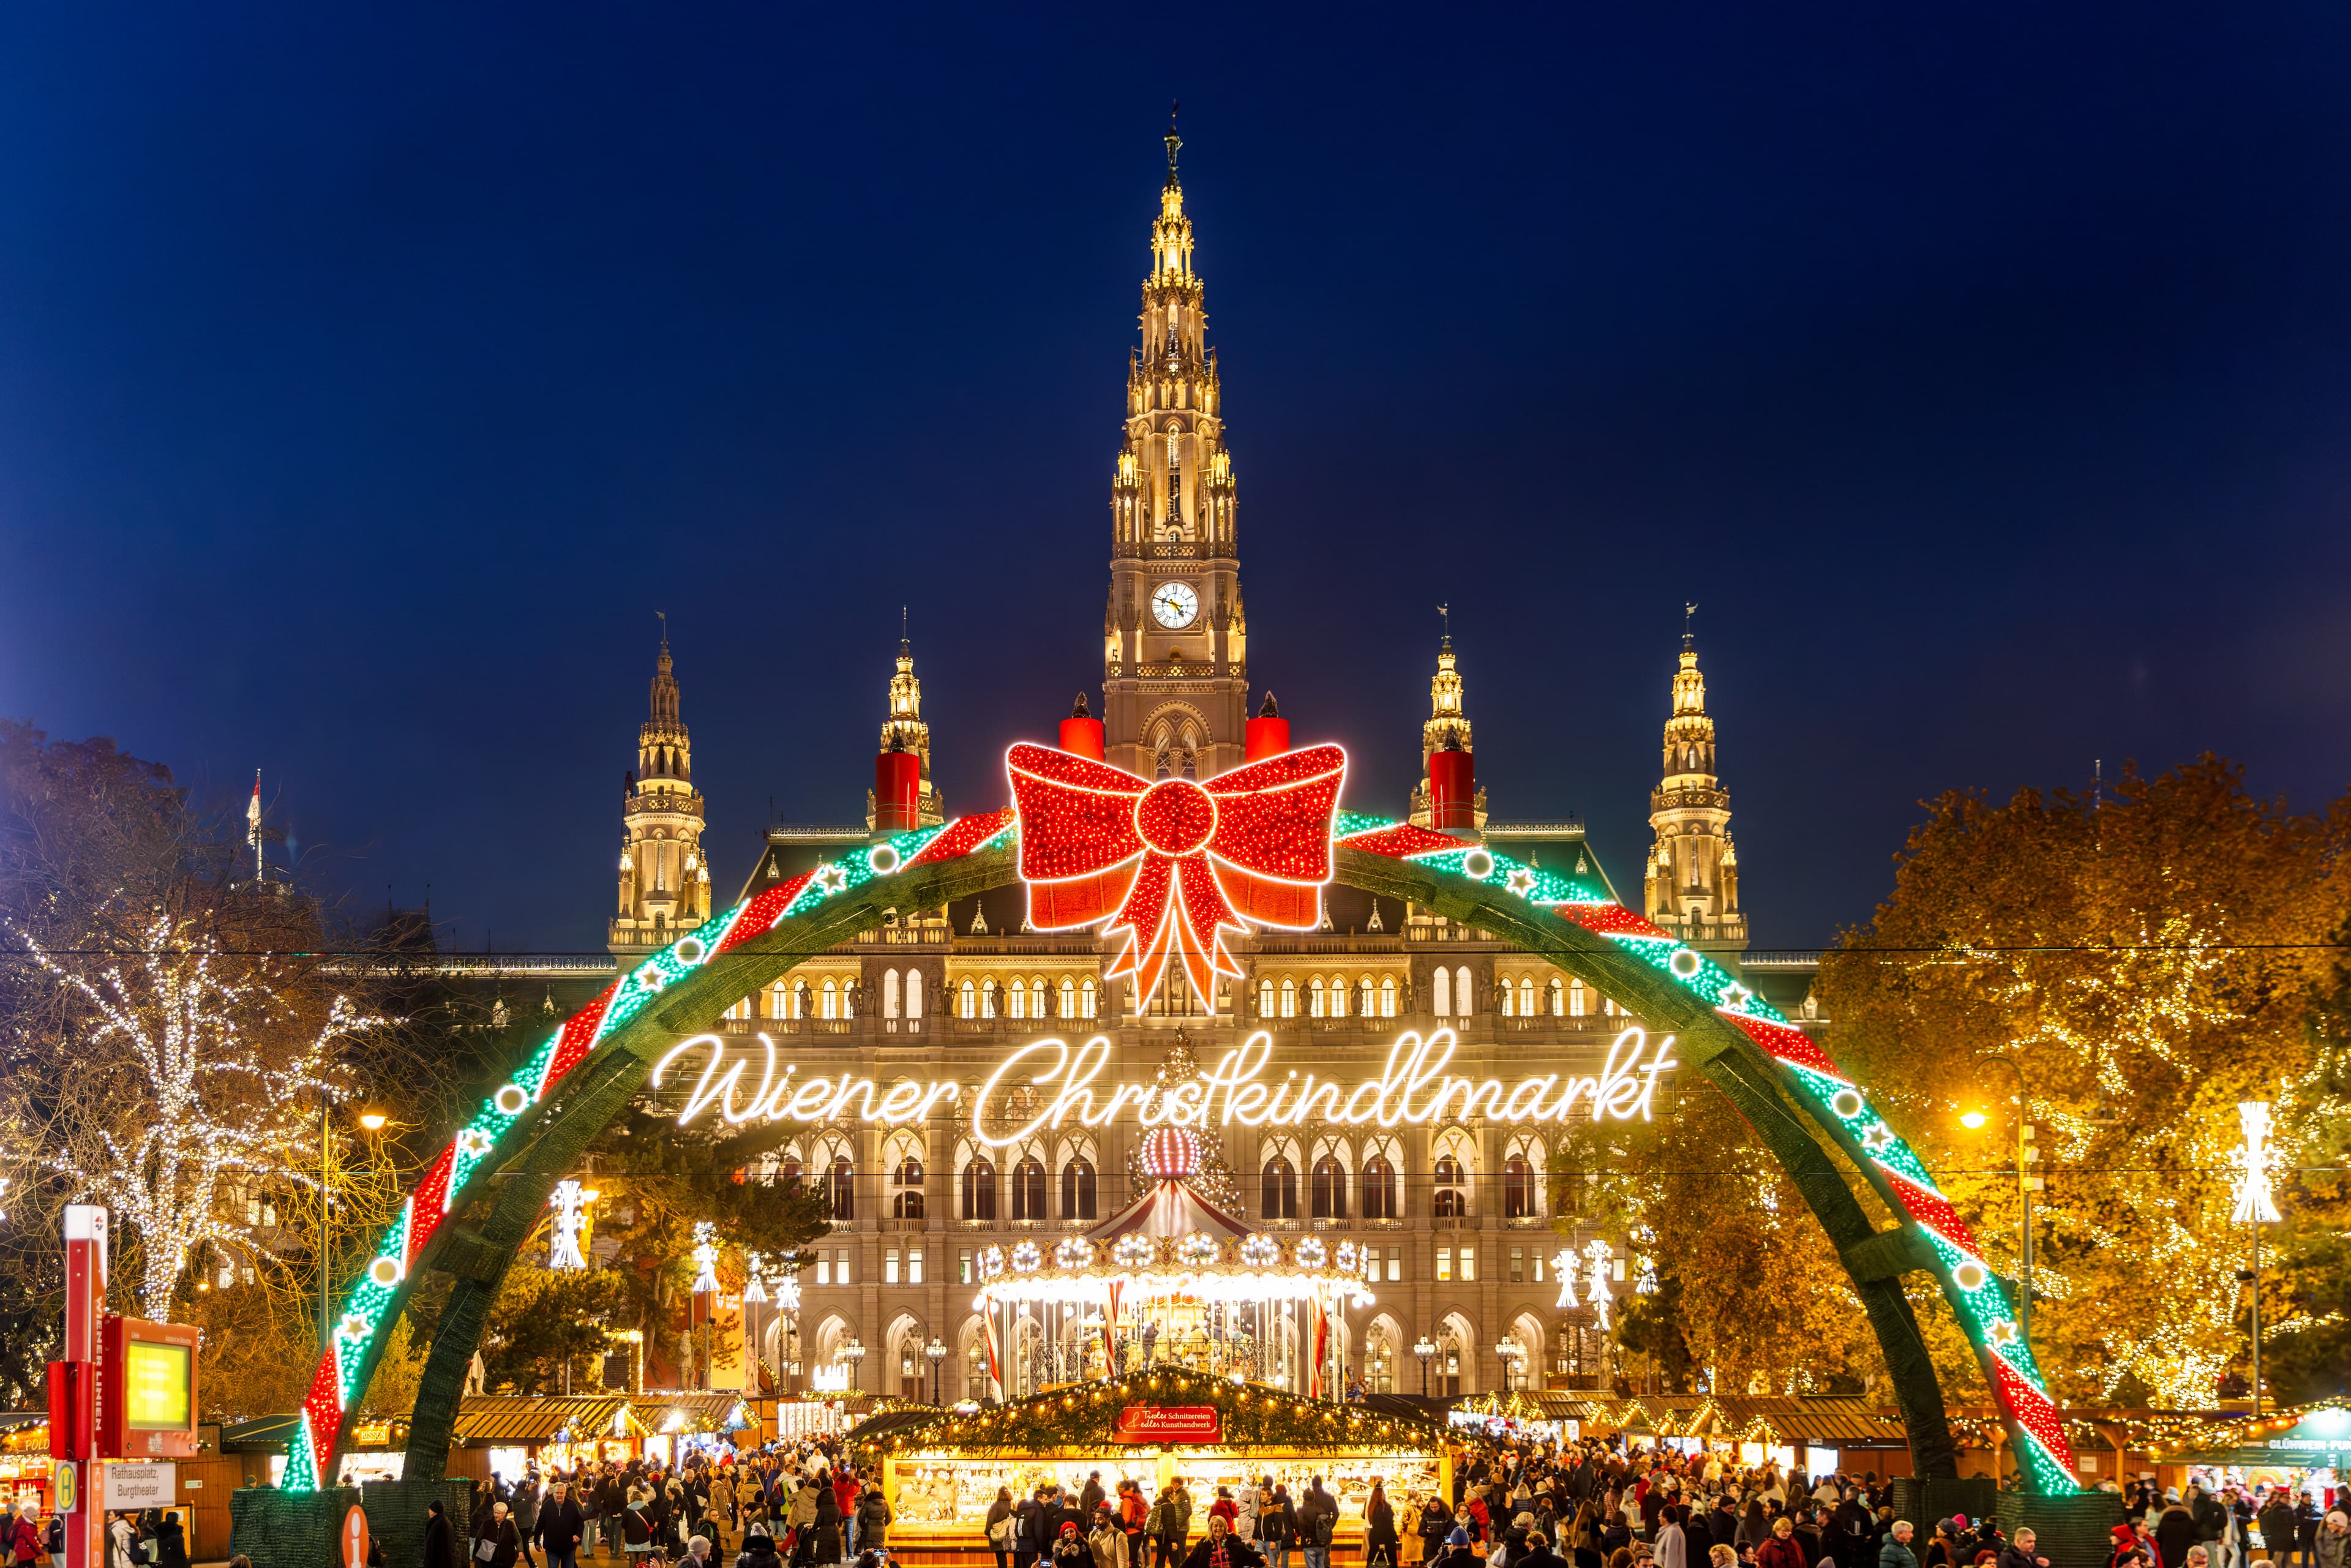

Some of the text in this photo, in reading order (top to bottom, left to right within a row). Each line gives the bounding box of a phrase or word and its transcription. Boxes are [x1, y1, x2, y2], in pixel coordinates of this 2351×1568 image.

[651, 1026, 1679, 1147] Wiener Christkindlmarkt
[1142, 1410, 1167, 1419] Tiroler
[1140, 1419, 1160, 1428] edles
[26, 1439, 50, 1451] POLD
[2268, 1438, 2327, 1450] GLÜHWEIN
[111, 1467, 159, 1482] Rathausplatz,
[118, 1484, 159, 1499] Burgtheater
